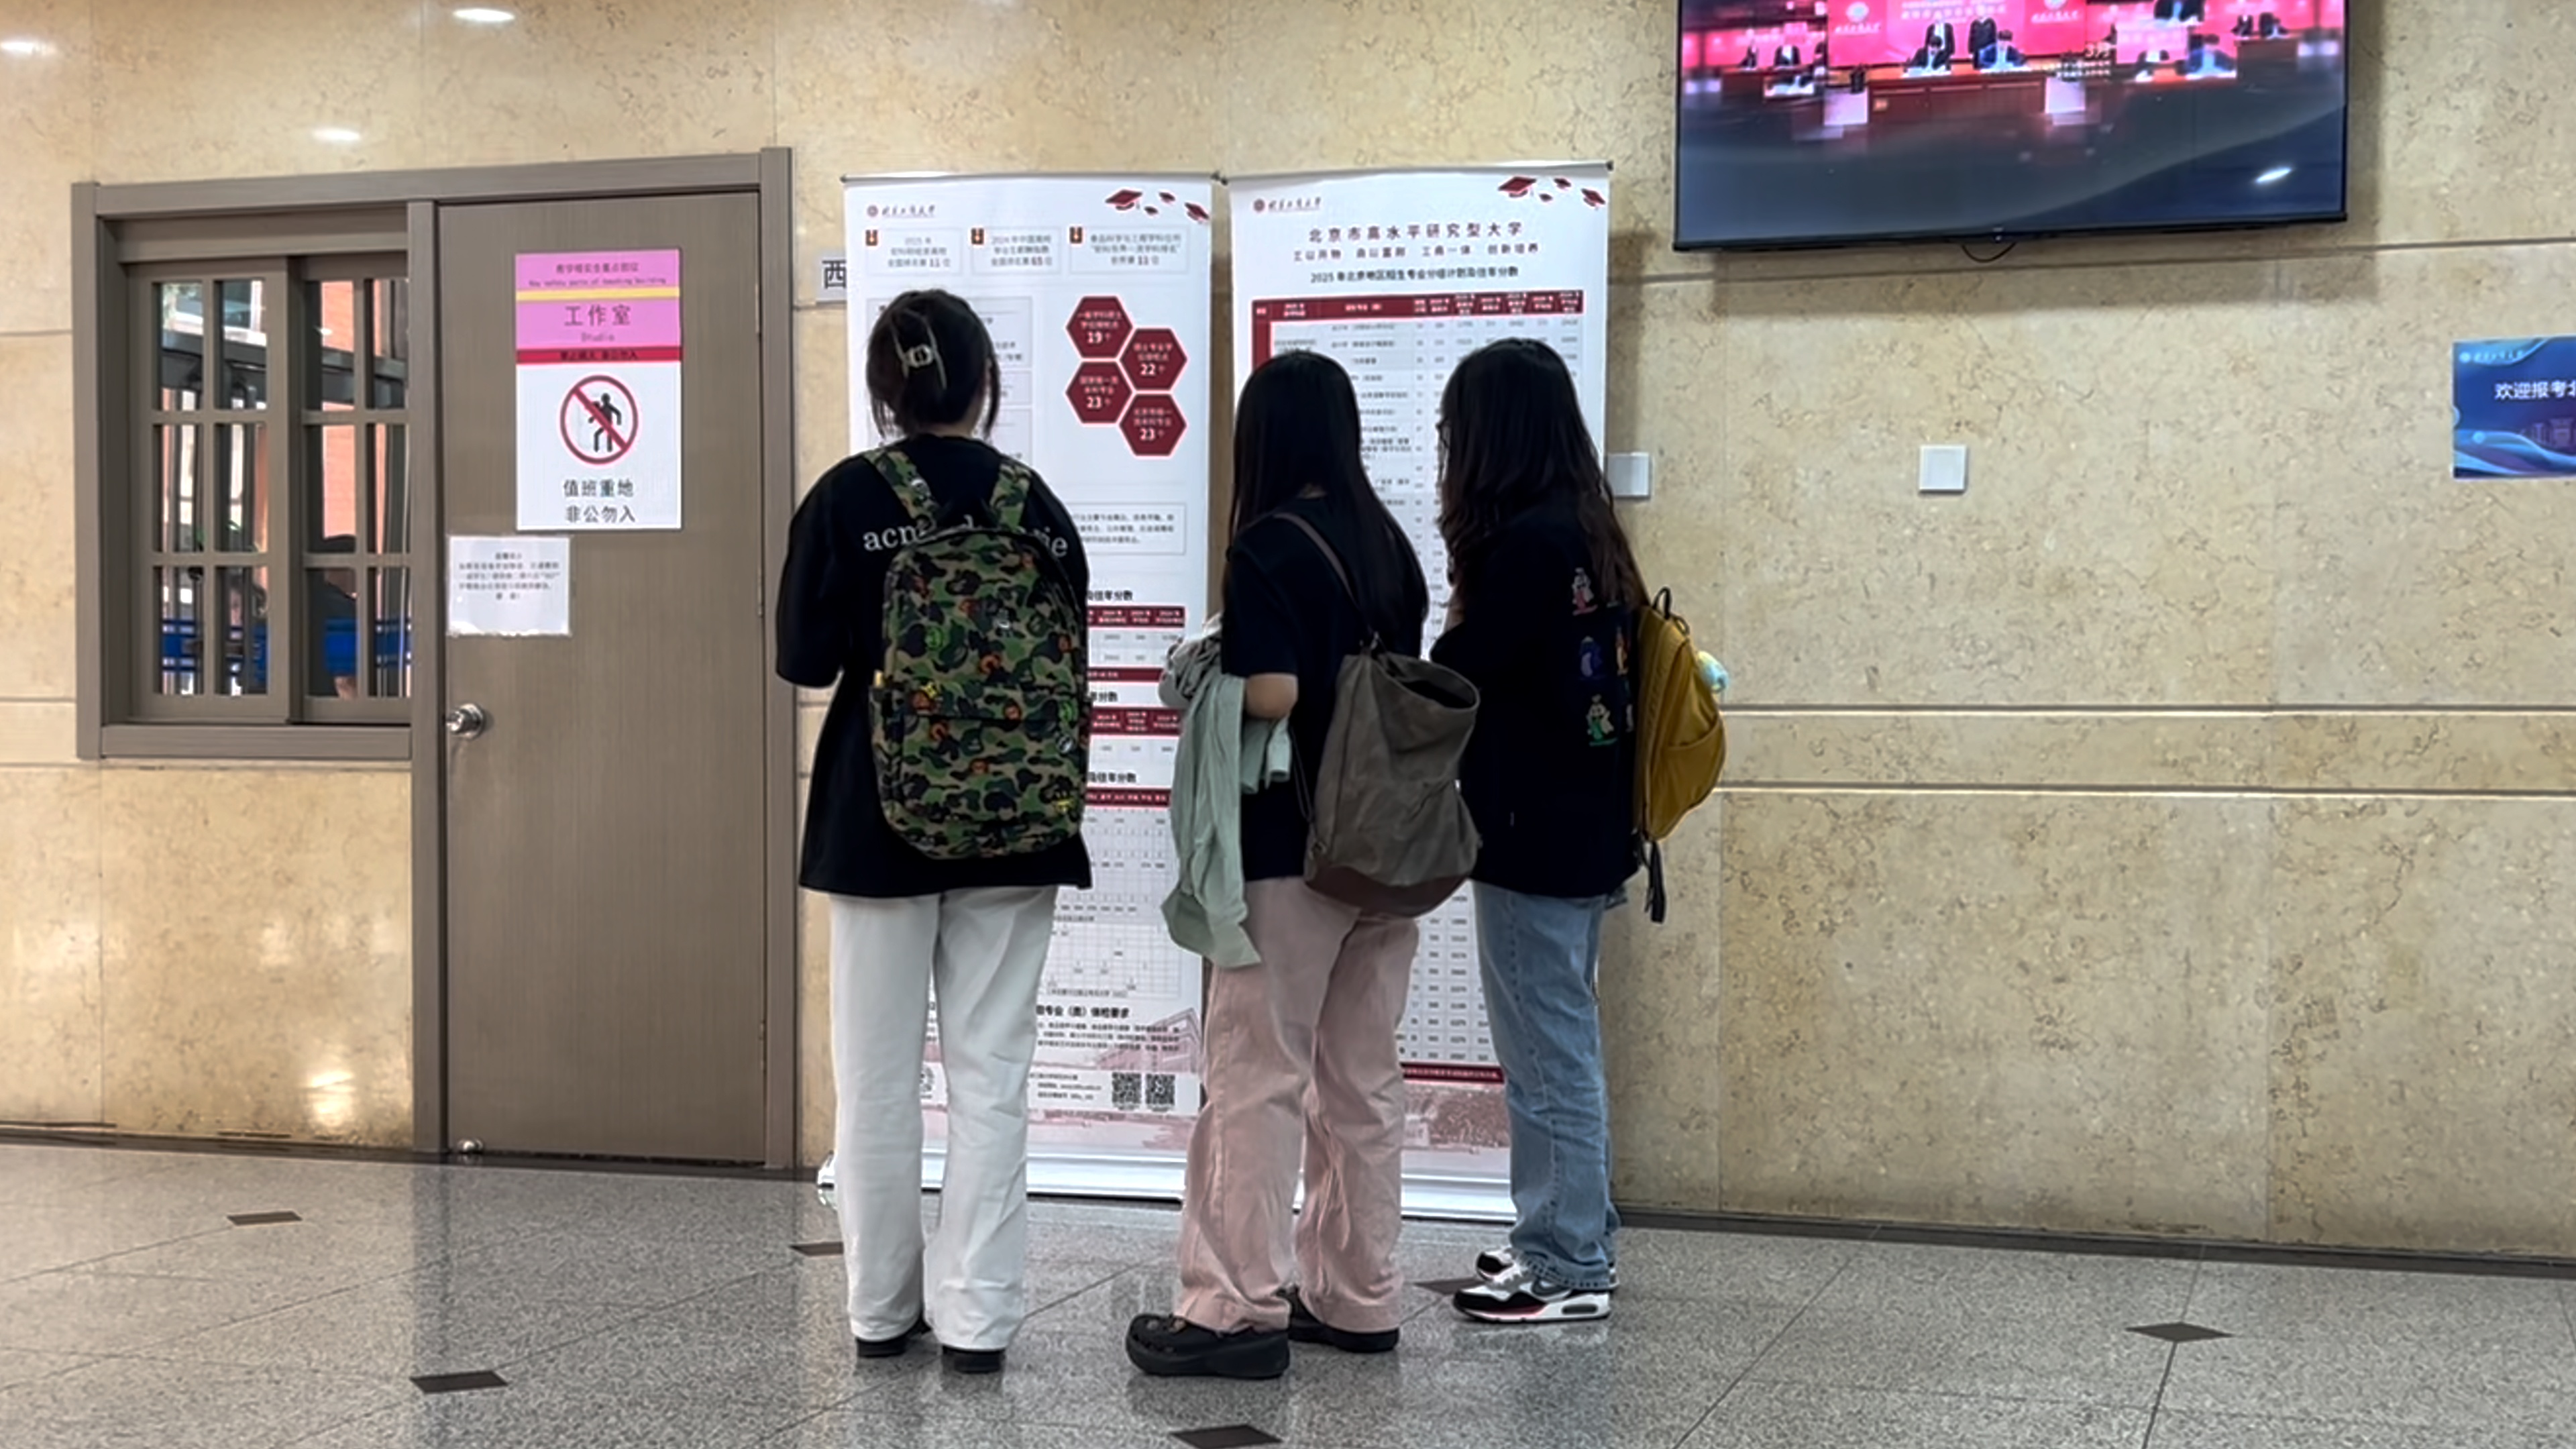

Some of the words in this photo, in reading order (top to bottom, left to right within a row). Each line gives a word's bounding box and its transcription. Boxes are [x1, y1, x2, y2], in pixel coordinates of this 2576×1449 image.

[1309, 221, 1521, 243] 北京市高水平研究型大学
[822, 260, 847, 289] 西
[564, 304, 631, 327] 工作室
[1087, 331, 1104, 344] 19
[1140, 364, 1157, 376] 22
[564, 479, 633, 497] 值班重地
[566, 505, 635, 523] 非公勿入
